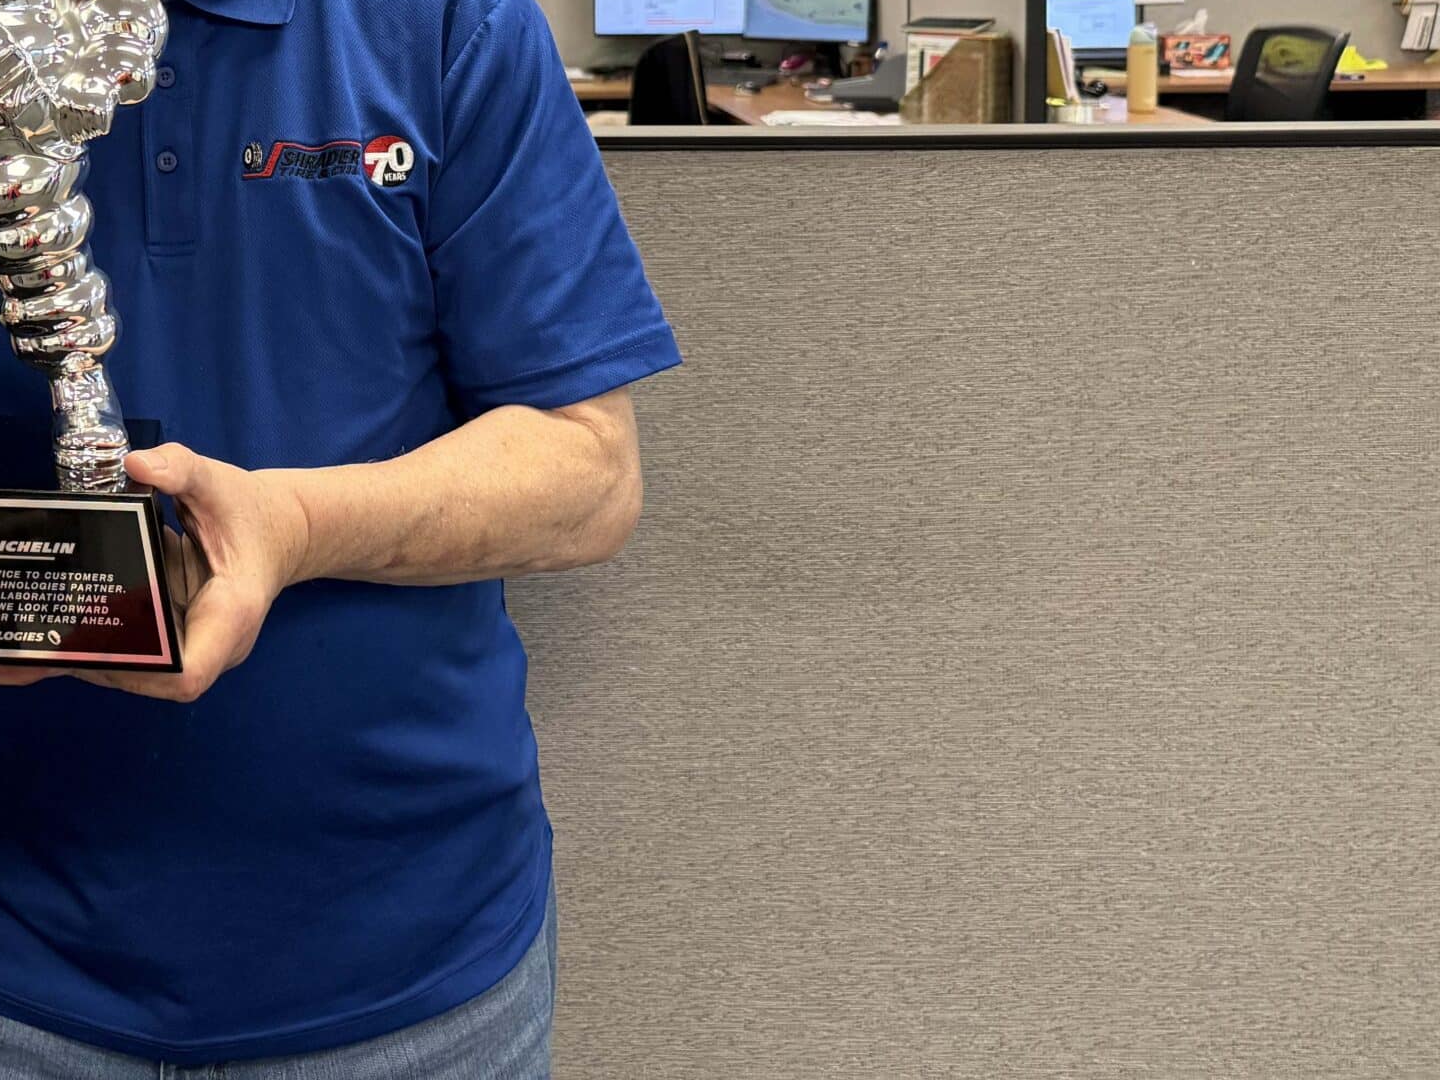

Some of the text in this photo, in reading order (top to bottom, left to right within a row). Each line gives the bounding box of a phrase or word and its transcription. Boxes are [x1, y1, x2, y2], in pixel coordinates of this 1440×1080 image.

[281, 149, 360, 169] SHRADER
[364, 141, 414, 186] 70
[384, 172, 407, 182] YEARS
[26, 570, 40, 580] TO
[44, 571, 115, 583] CUSTOMERS
[70, 583, 127, 594] PARTNER.
[77, 594, 108, 604] HAVE
[18, 603, 48, 613] LOOK
[53, 604, 109, 615] FORWARD
[13, 613, 35, 623] THE
[39, 614, 77, 624] YEARS
[81, 616, 124, 627] AHEAD.
